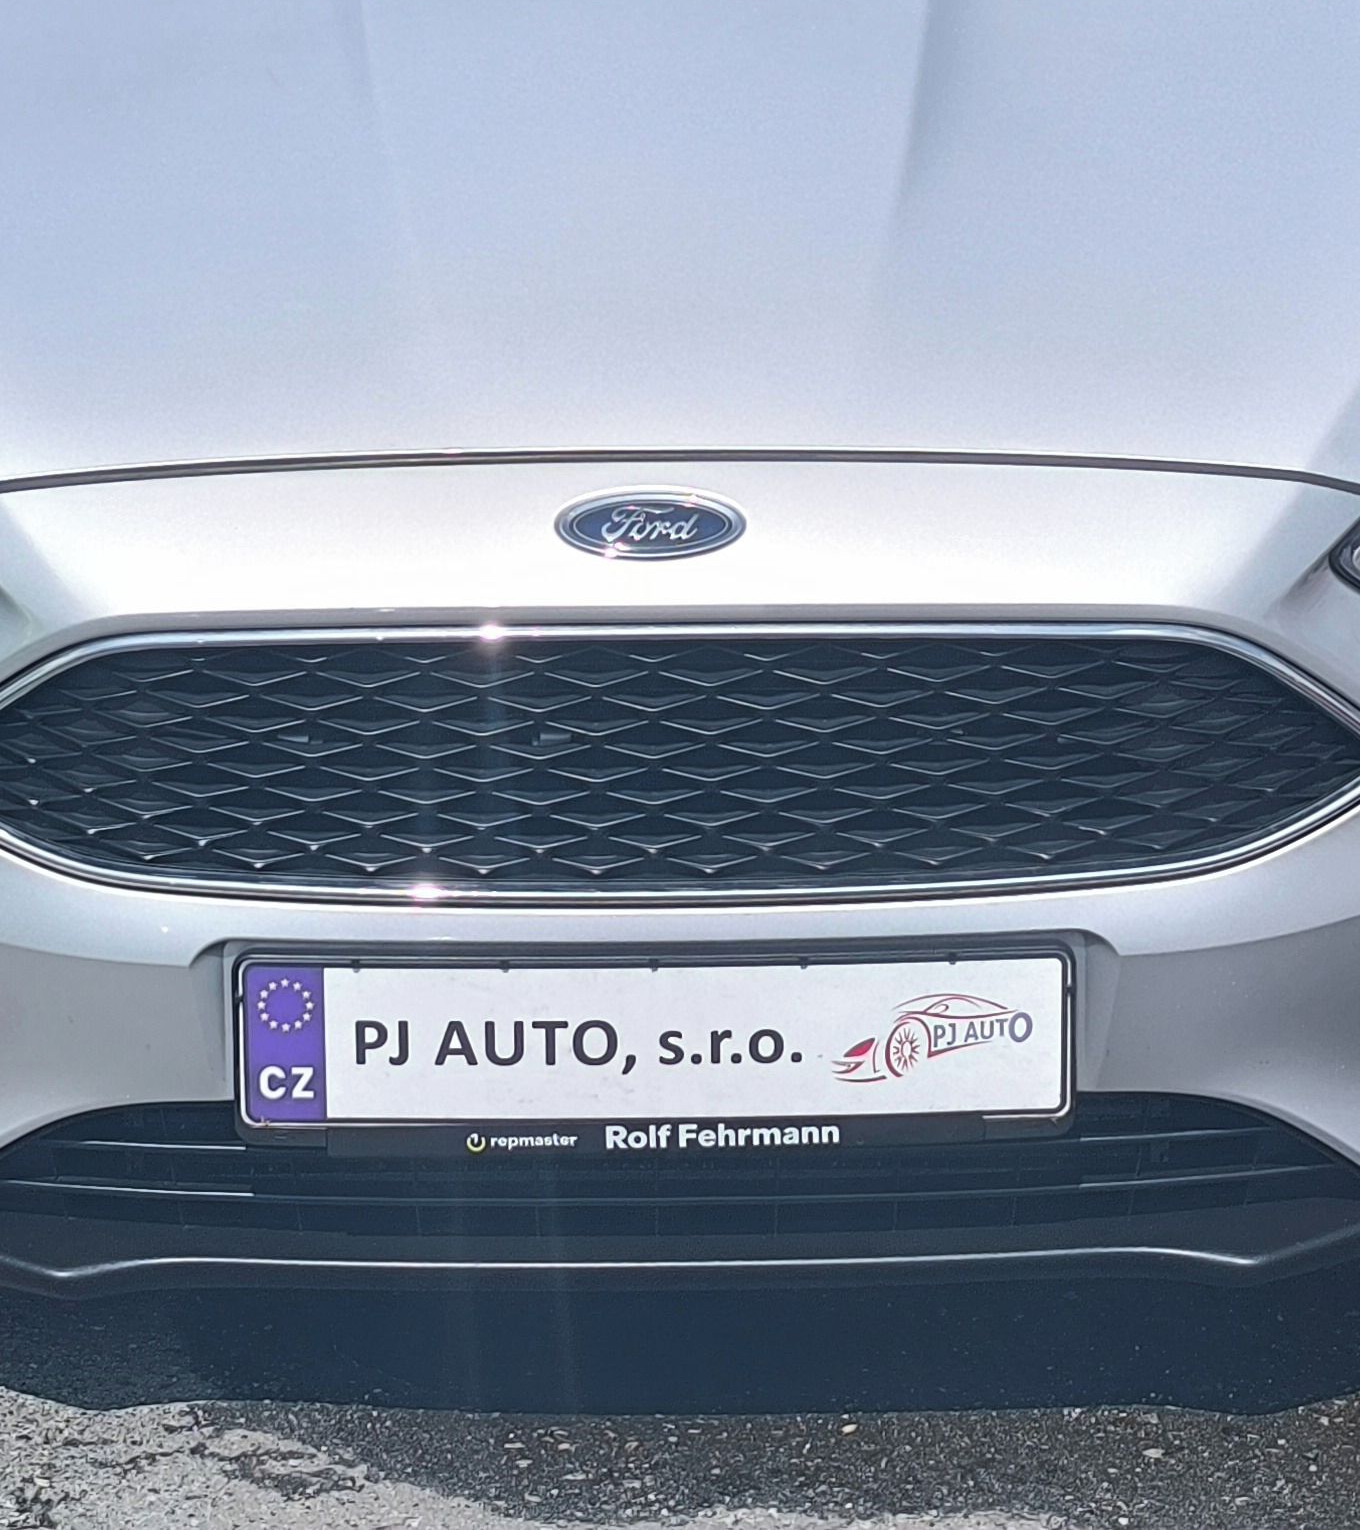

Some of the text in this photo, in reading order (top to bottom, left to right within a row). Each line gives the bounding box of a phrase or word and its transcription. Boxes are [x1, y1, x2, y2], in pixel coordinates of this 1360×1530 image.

[601, 505, 700, 544] Ford
[354, 1018, 804, 1077] PJ AUTO, s.r.o.
[933, 1011, 1033, 1048] PJ AUTO
[257, 1064, 316, 1102] CZ
[489, 1123, 841, 1151] repmaster Rolf Fehrmann
